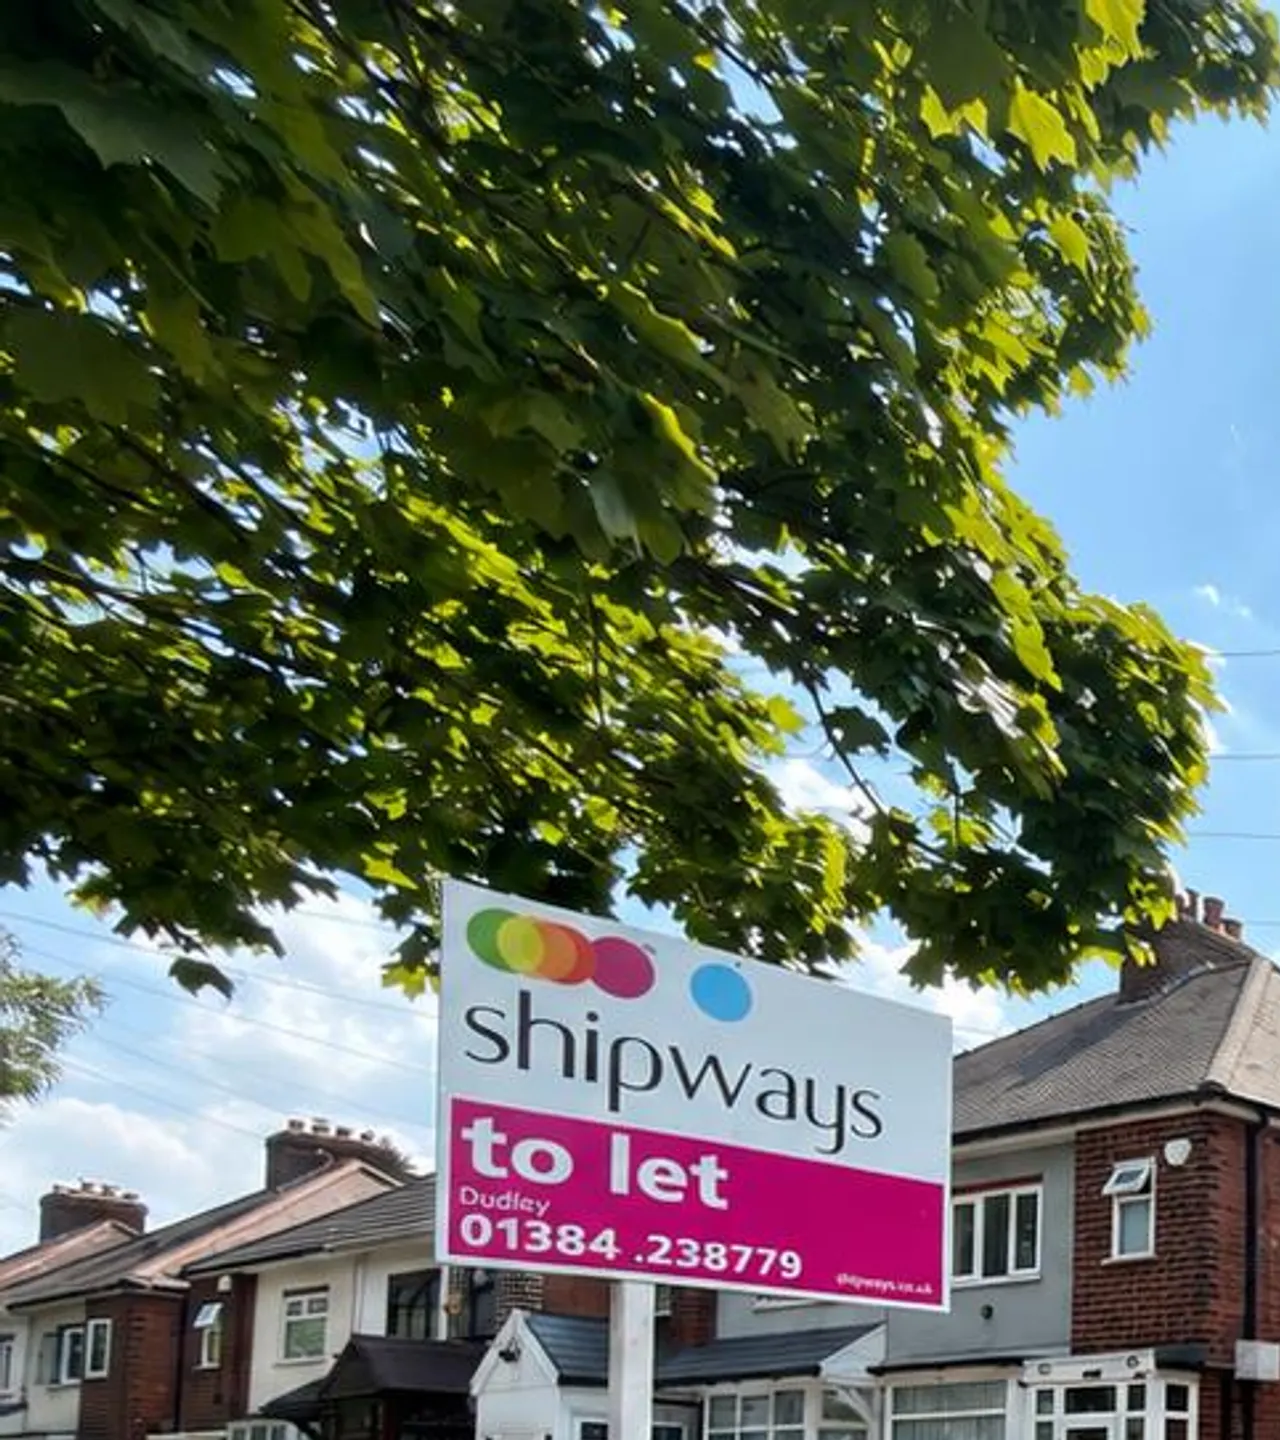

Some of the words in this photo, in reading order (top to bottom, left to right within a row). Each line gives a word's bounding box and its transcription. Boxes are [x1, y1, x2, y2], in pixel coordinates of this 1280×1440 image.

[464, 989, 884, 1155] shipways
[460, 1115, 575, 1185] to
[609, 1132, 730, 1210] let
[459, 1186, 551, 1217] Dudley
[459, 1213, 621, 1261] 01384
